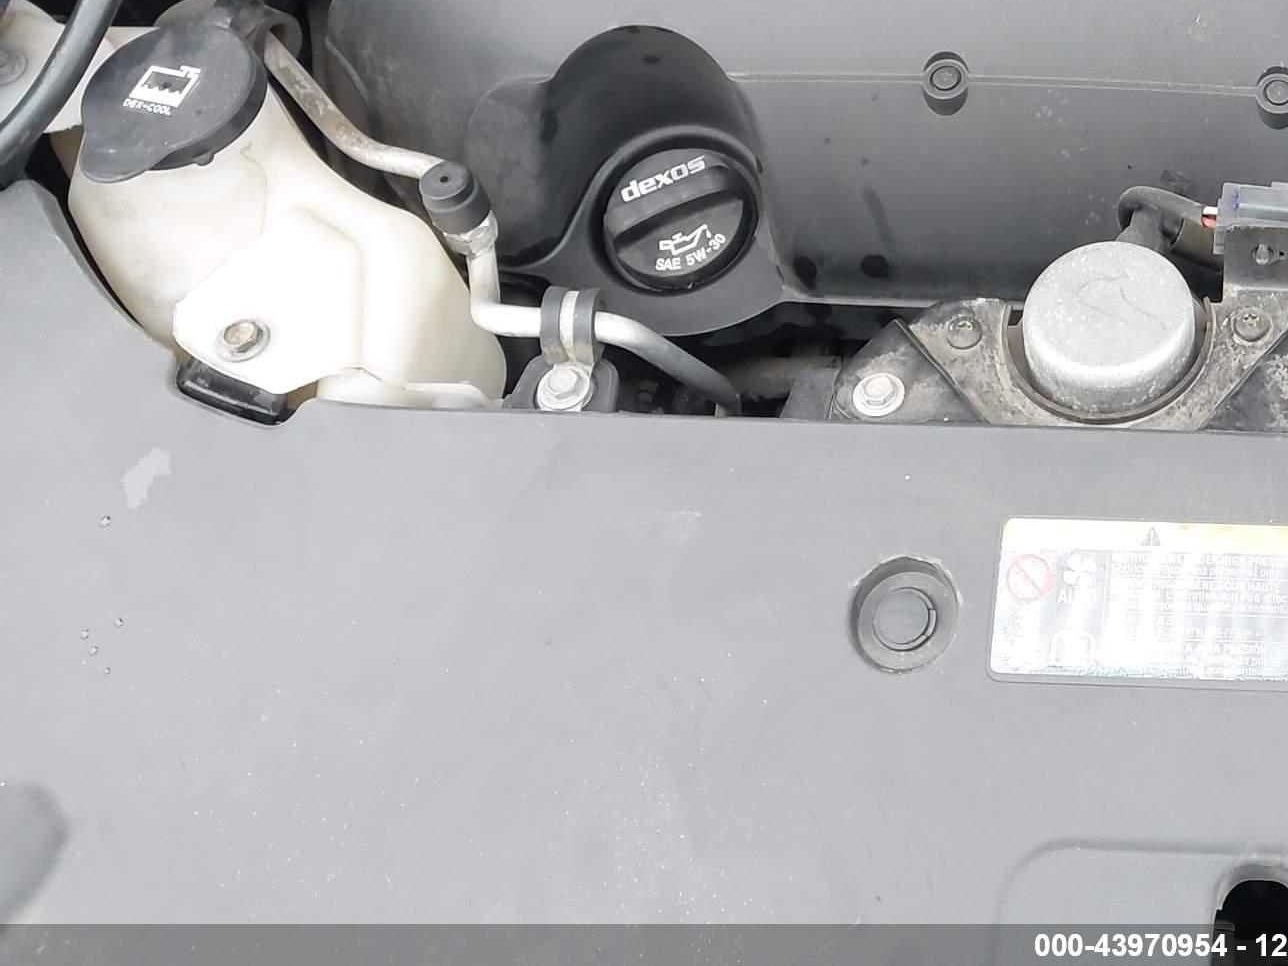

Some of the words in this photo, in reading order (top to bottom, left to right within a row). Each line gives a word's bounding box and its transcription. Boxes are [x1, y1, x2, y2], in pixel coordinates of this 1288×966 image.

[122, 99, 172, 116] DEX-COOL
[621, 155, 706, 202] dexos
[655, 257, 682, 272] SAE
[686, 233, 727, 267] 5W-30
